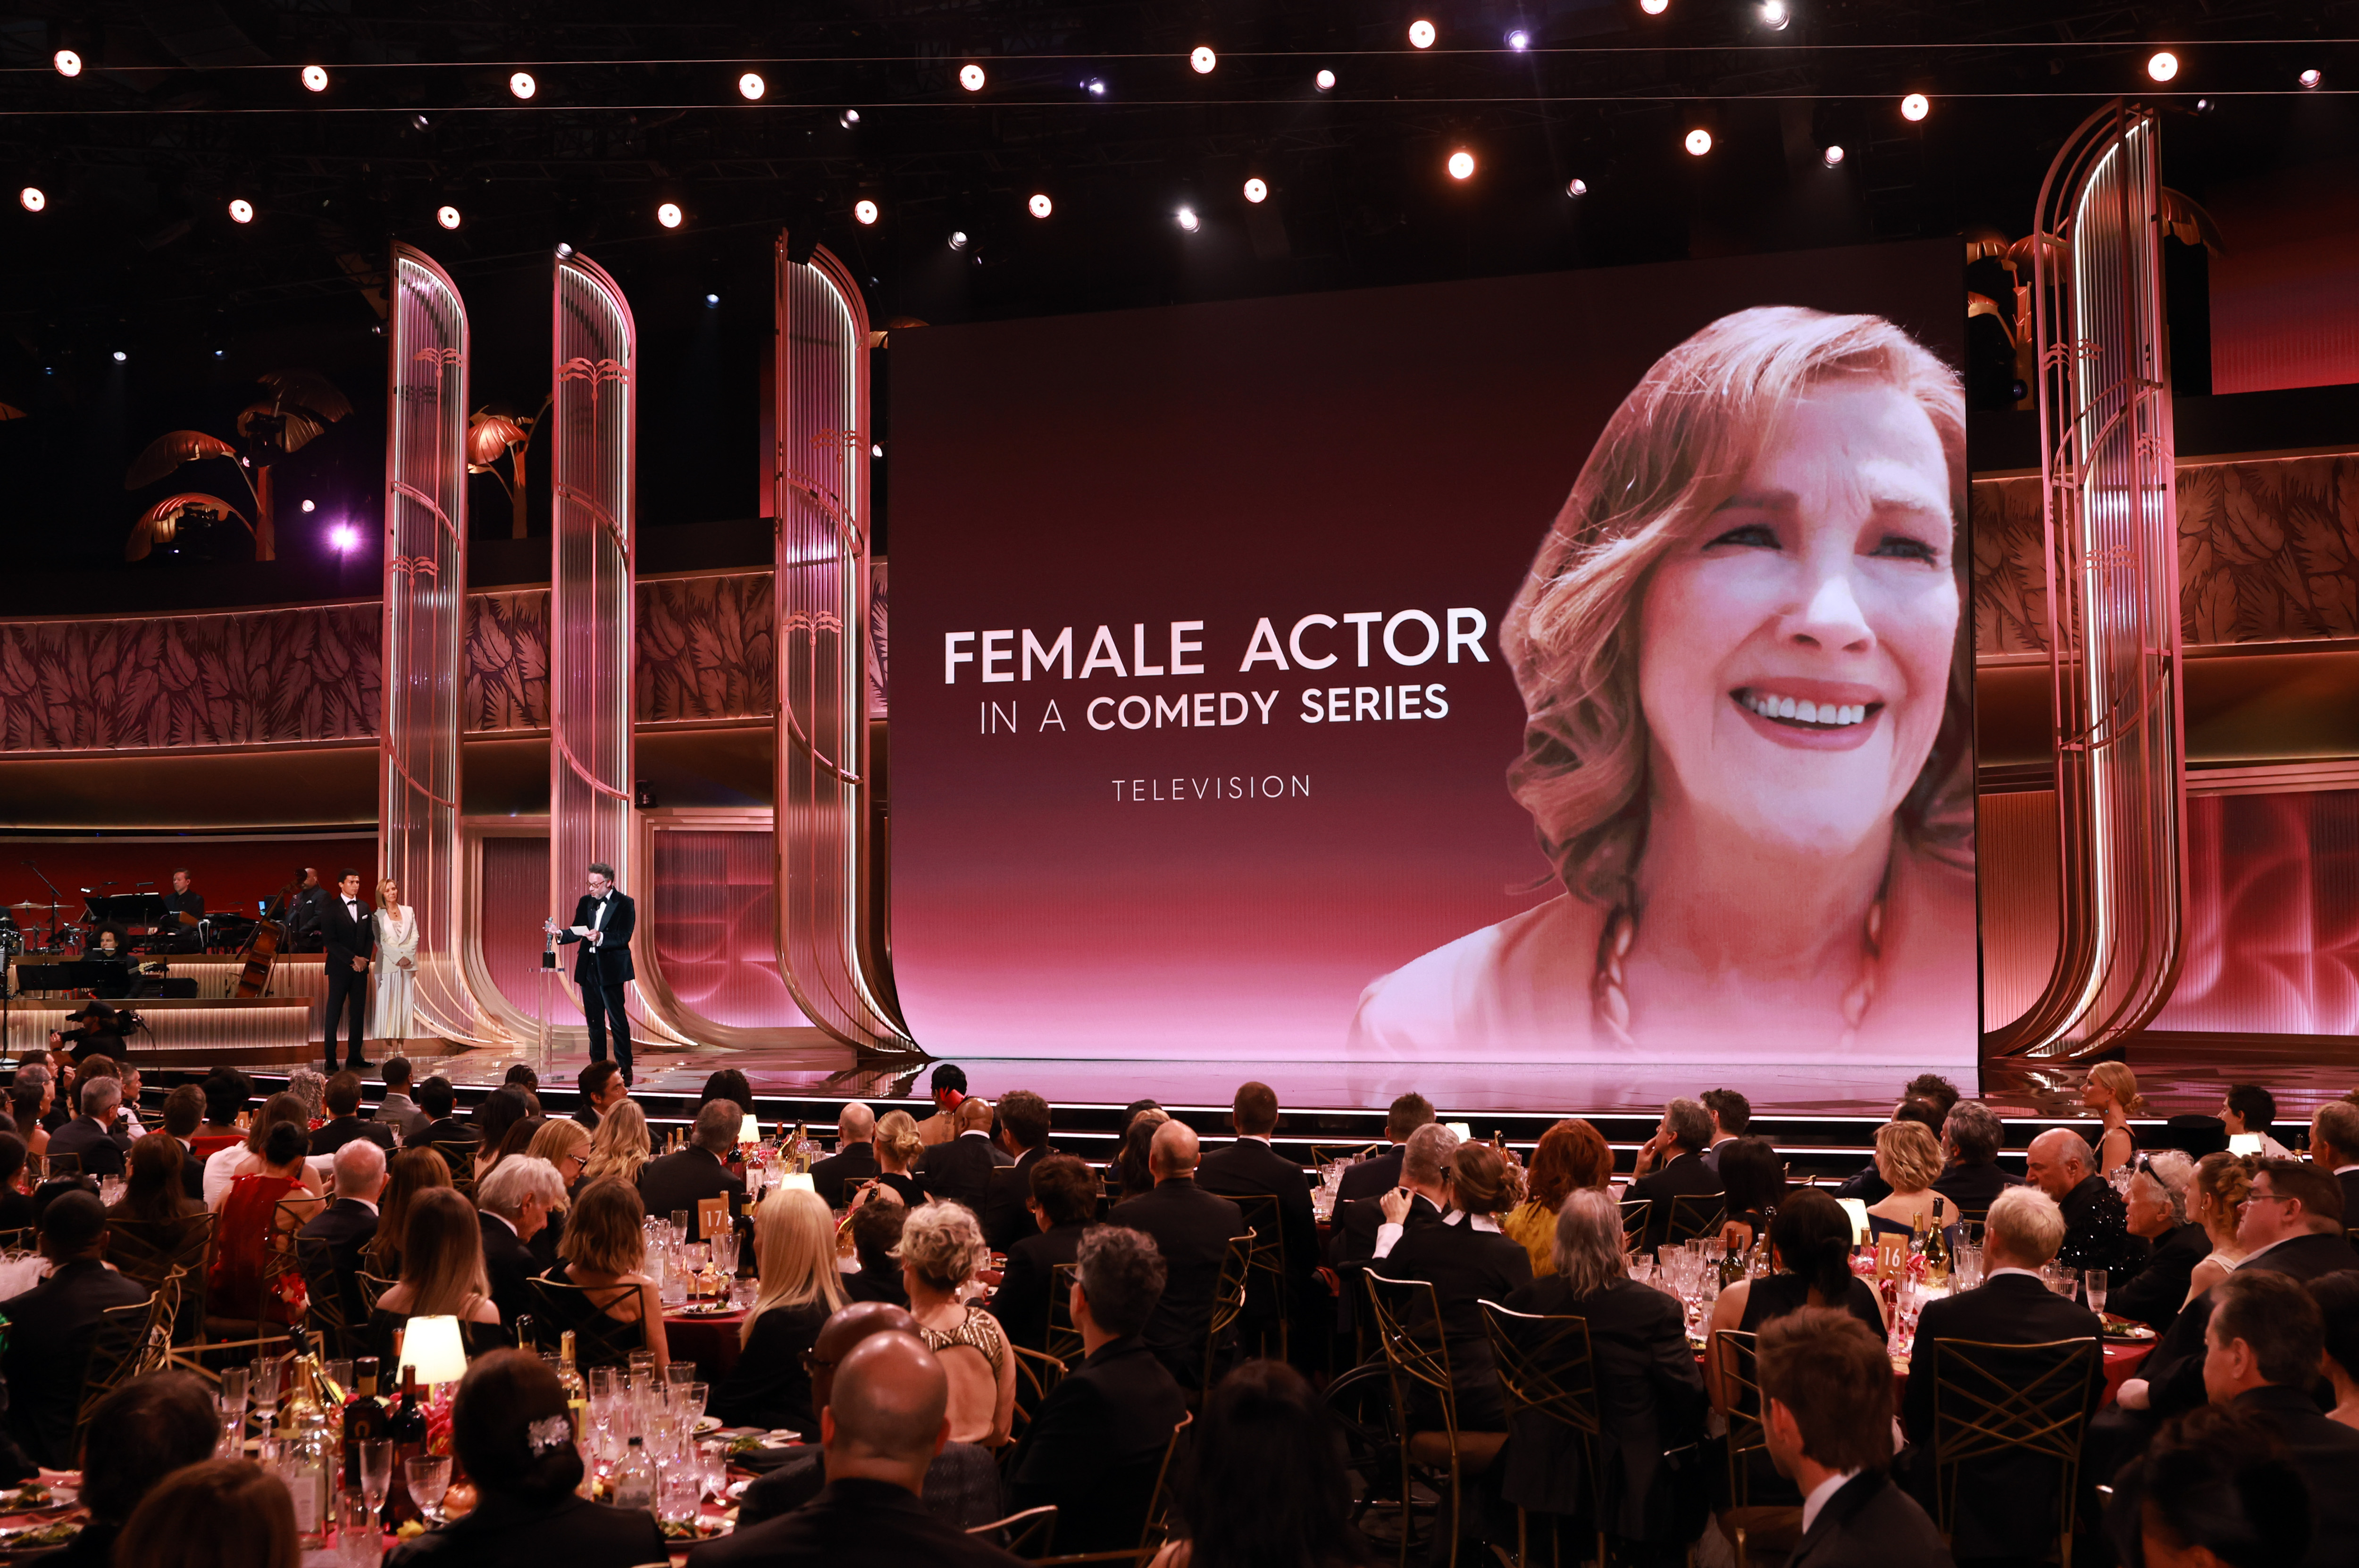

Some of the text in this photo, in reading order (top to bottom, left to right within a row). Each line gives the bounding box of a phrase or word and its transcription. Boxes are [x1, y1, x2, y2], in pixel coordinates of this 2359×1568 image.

[945, 607, 1490, 684] FEMALE ACTOR
[981, 683, 1448, 734] IN A COMEDY SERIES
[1111, 775, 1309, 801] TELEVISION
[240, 1119, 243, 1128] 9
[706, 1210, 722, 1227] 17
[1885, 1247, 1900, 1267] 16
